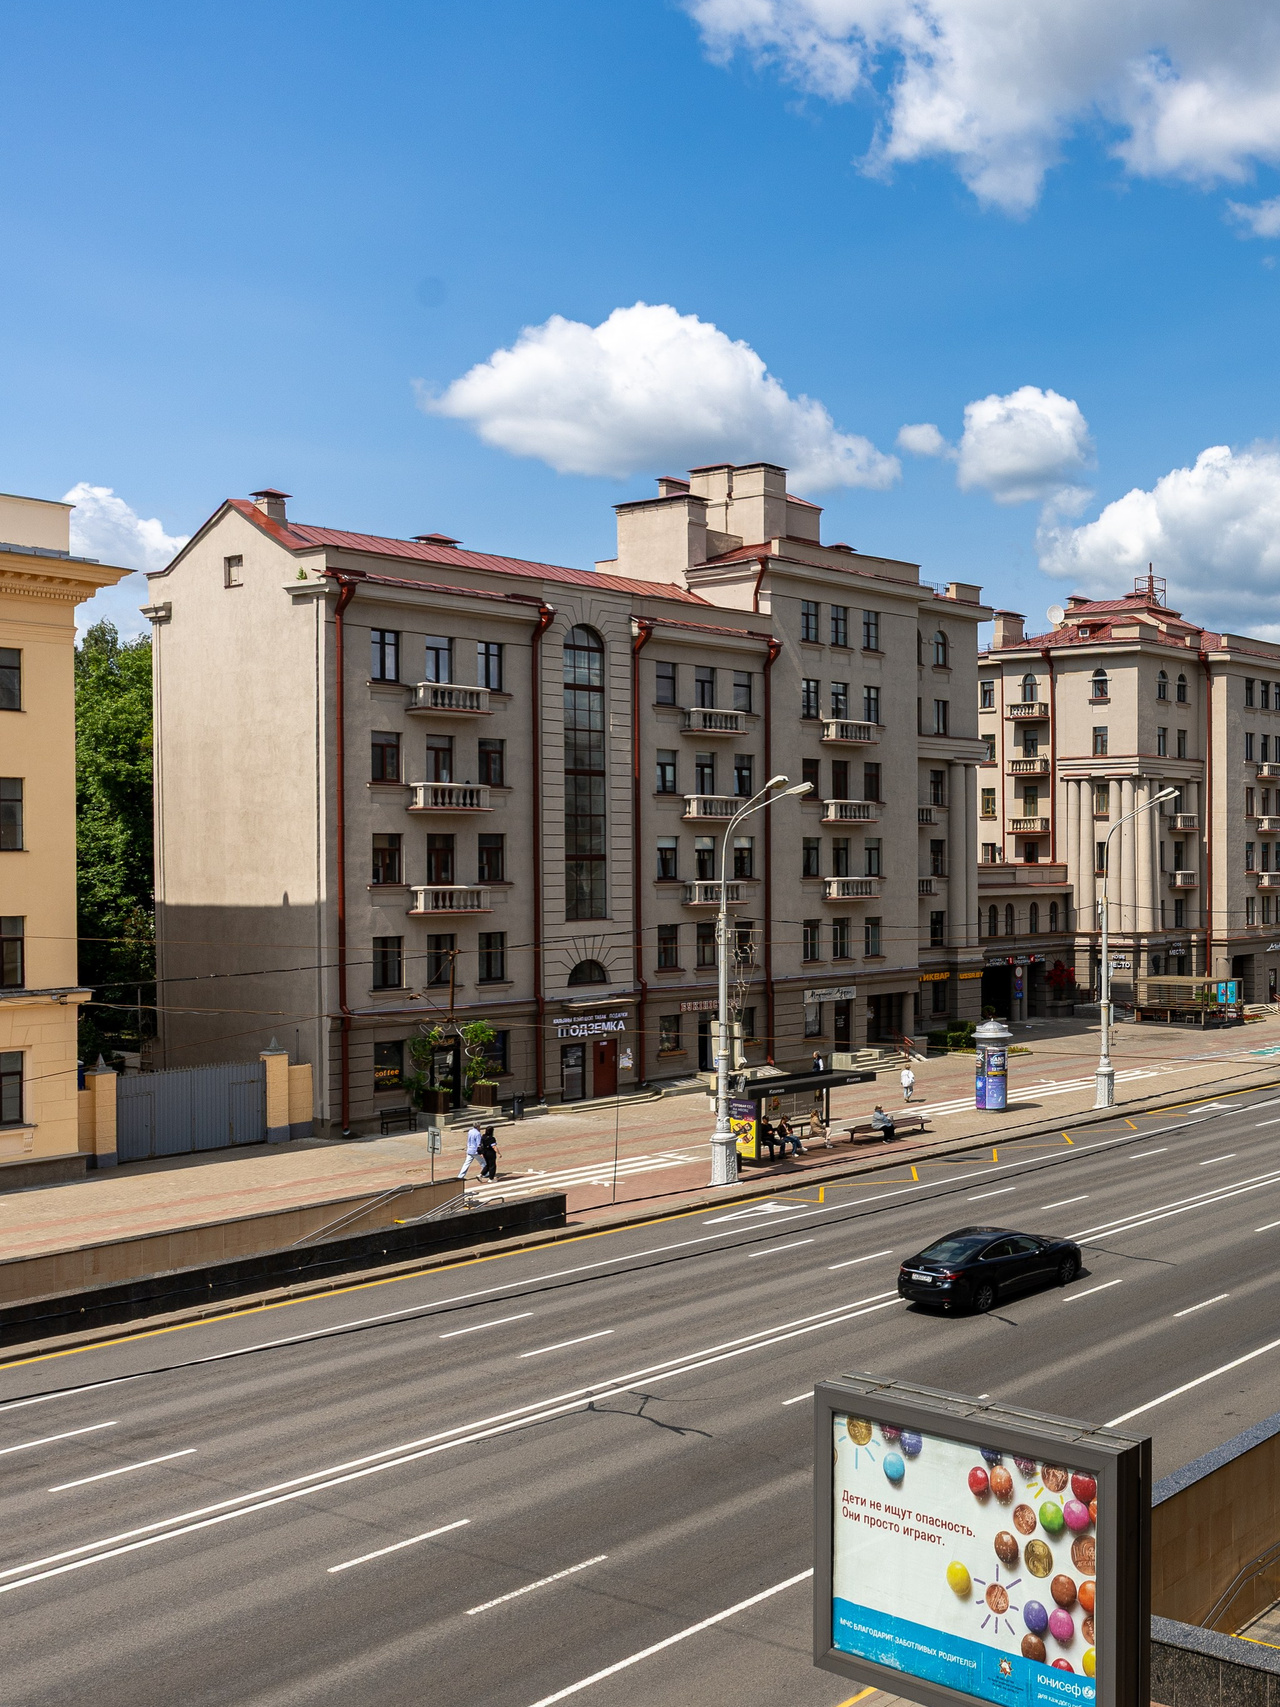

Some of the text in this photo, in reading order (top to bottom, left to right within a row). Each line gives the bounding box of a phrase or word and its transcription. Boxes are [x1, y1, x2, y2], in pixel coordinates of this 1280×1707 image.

[557, 1020, 626, 1038] ПОДЗЕМКА
[375, 1069, 400, 1078] coffee
[842, 1489, 976, 1538] Дети не ищут опасность.
[842, 1506, 945, 1546] Они просто играют.
[839, 1617, 977, 1670] МЧС БЛАГОДАРИТ ЗАБОТЛИВЫХ РОДИТЕЛЕЙ
